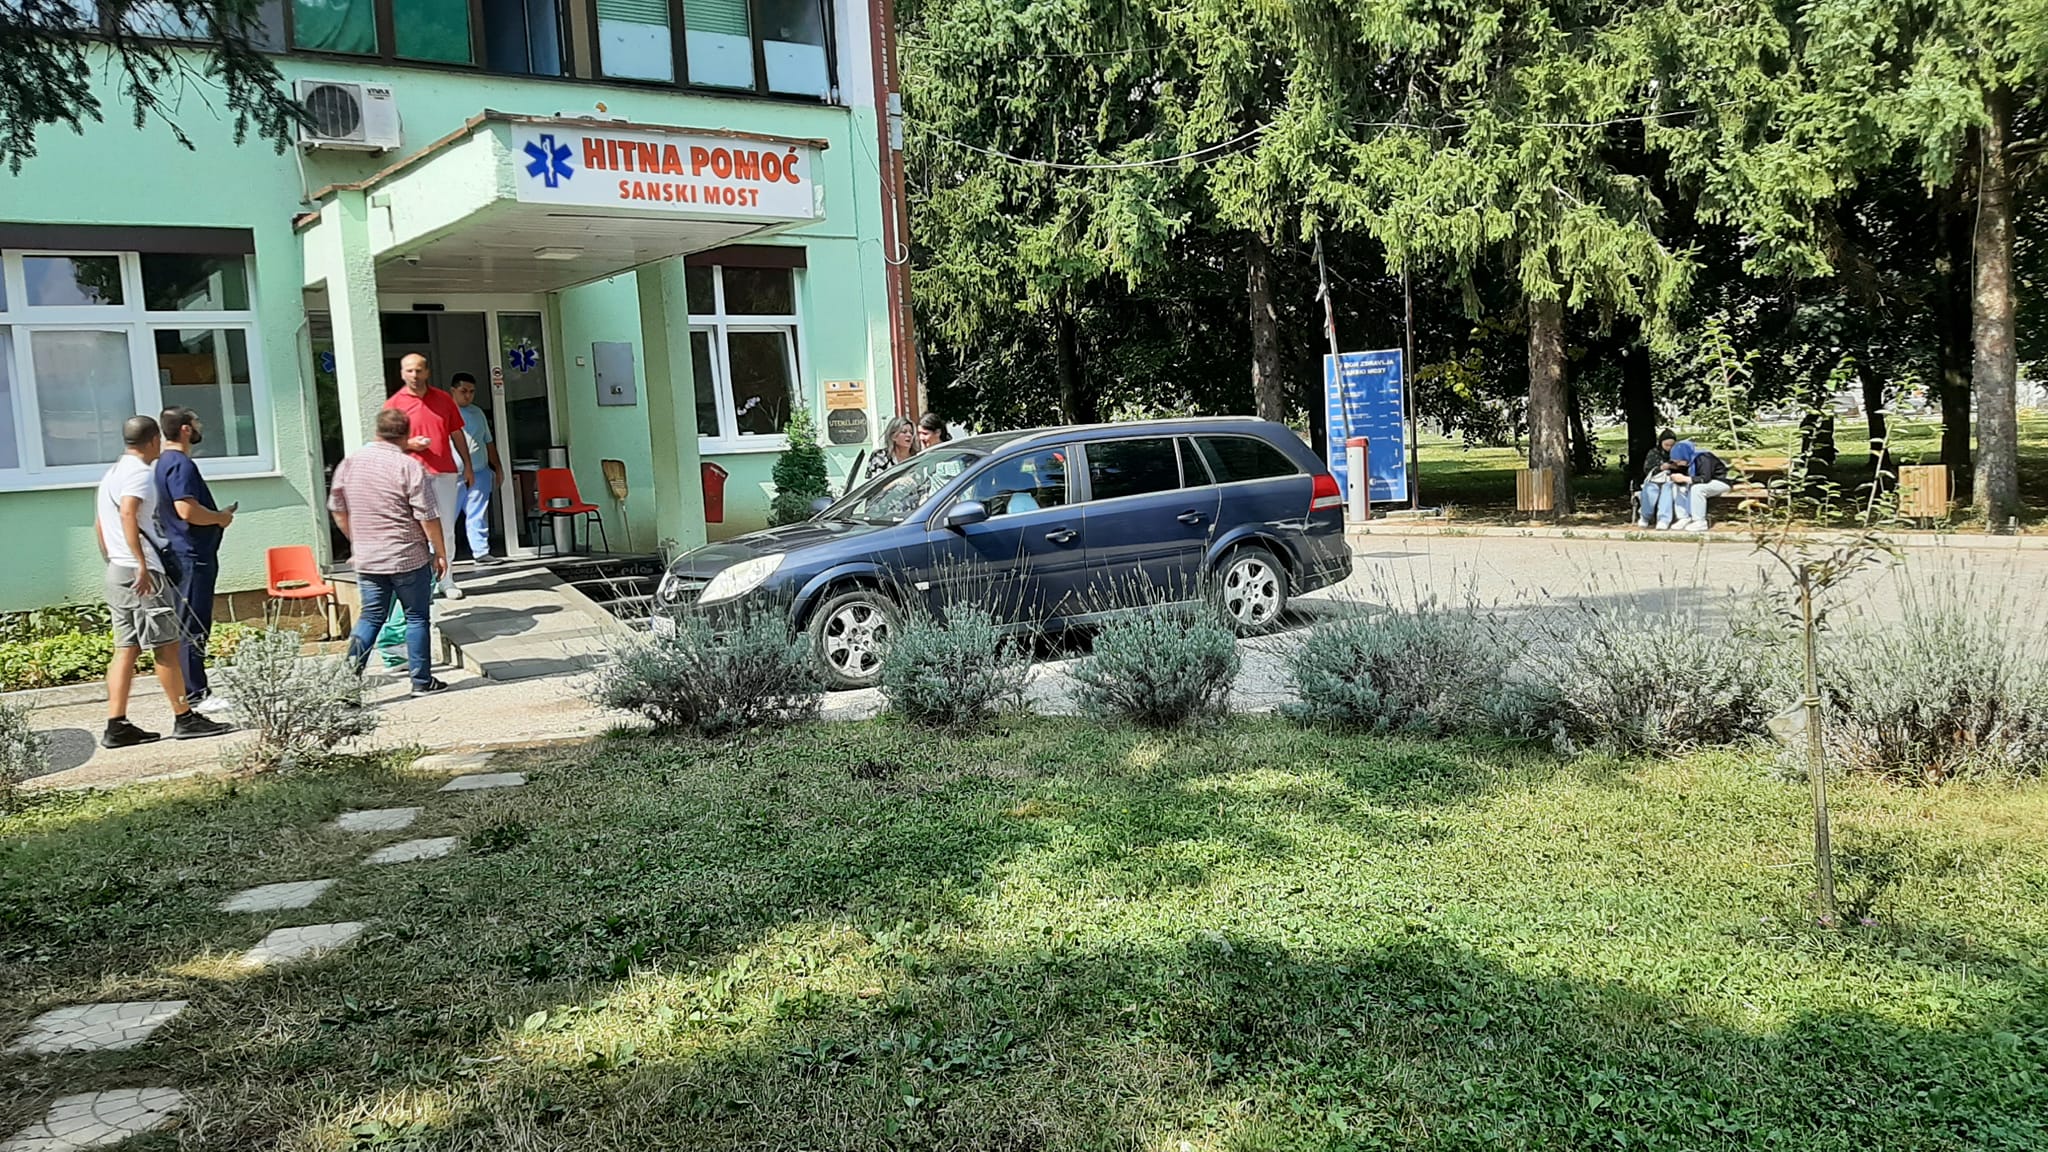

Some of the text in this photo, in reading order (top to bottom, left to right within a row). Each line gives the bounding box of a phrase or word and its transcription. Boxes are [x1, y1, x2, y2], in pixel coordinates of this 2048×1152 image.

[582, 136, 801, 185] HITNA POMOĆ
[619, 180, 760, 208] SANSKI MOST
